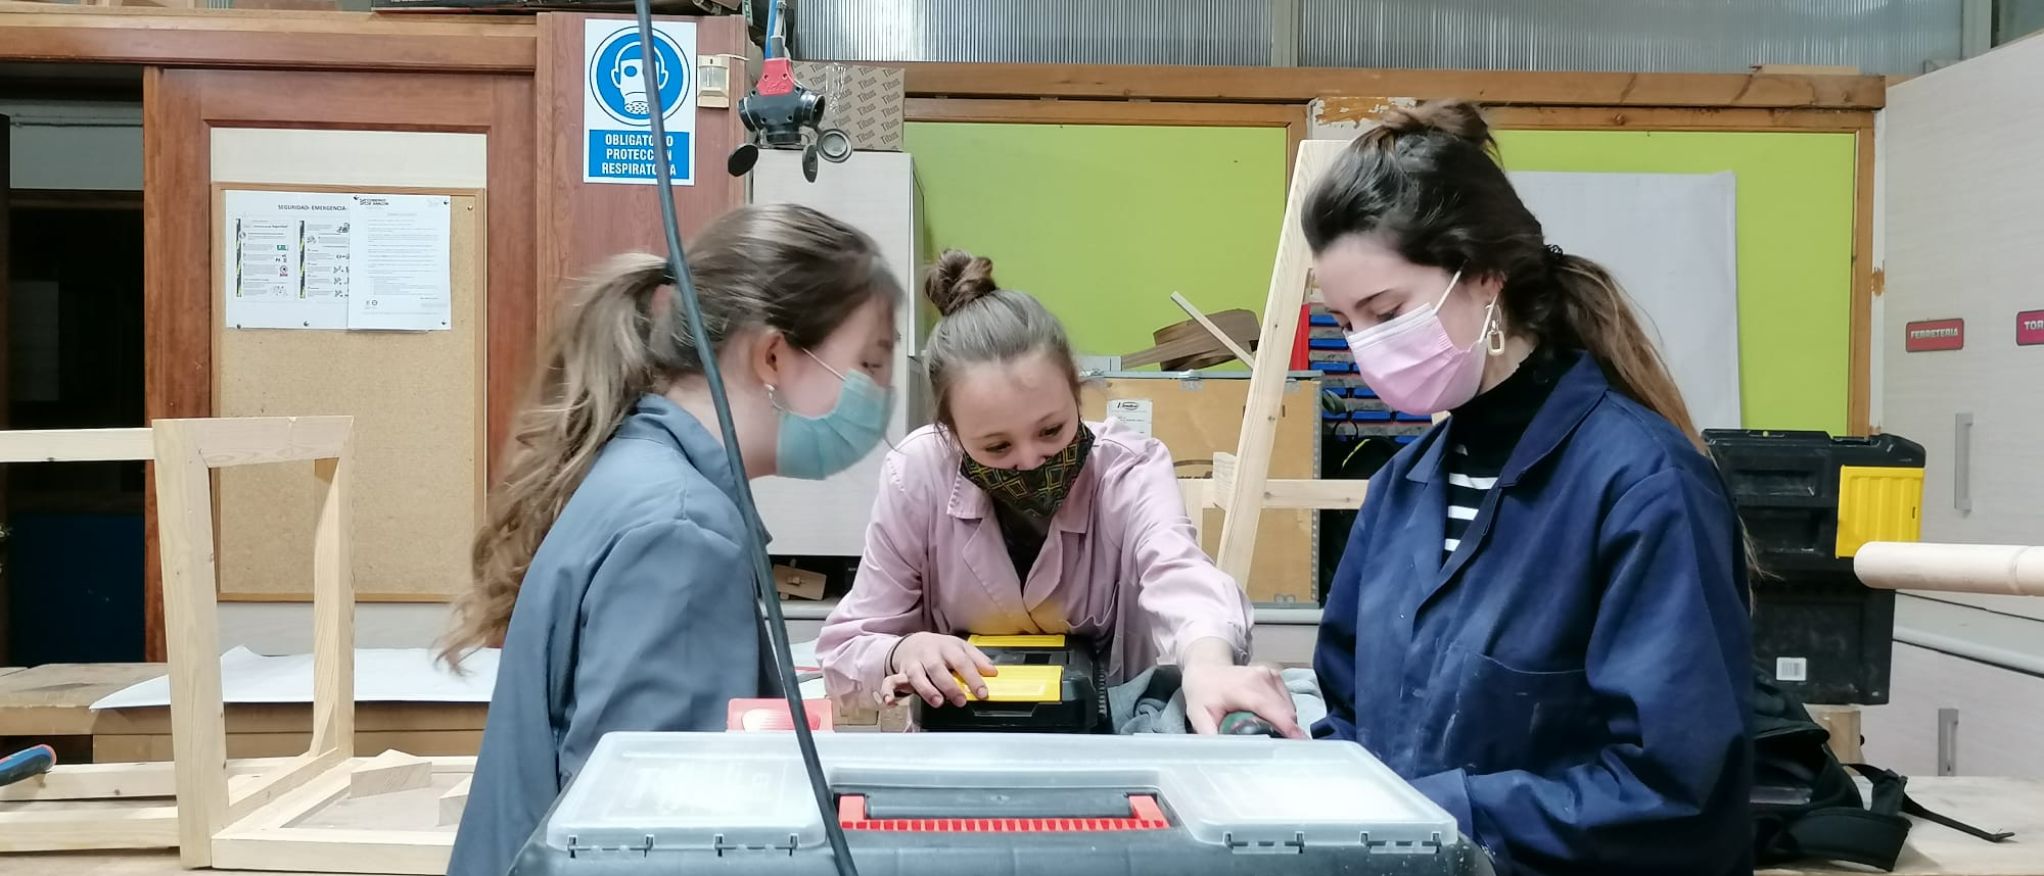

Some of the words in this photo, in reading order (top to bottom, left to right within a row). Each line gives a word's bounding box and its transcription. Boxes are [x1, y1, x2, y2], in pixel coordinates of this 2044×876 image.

[605, 133, 673, 146] OBLIGATOO
[606, 148, 672, 161] PROTECCN
[602, 162, 677, 175] RESPIRATOA
